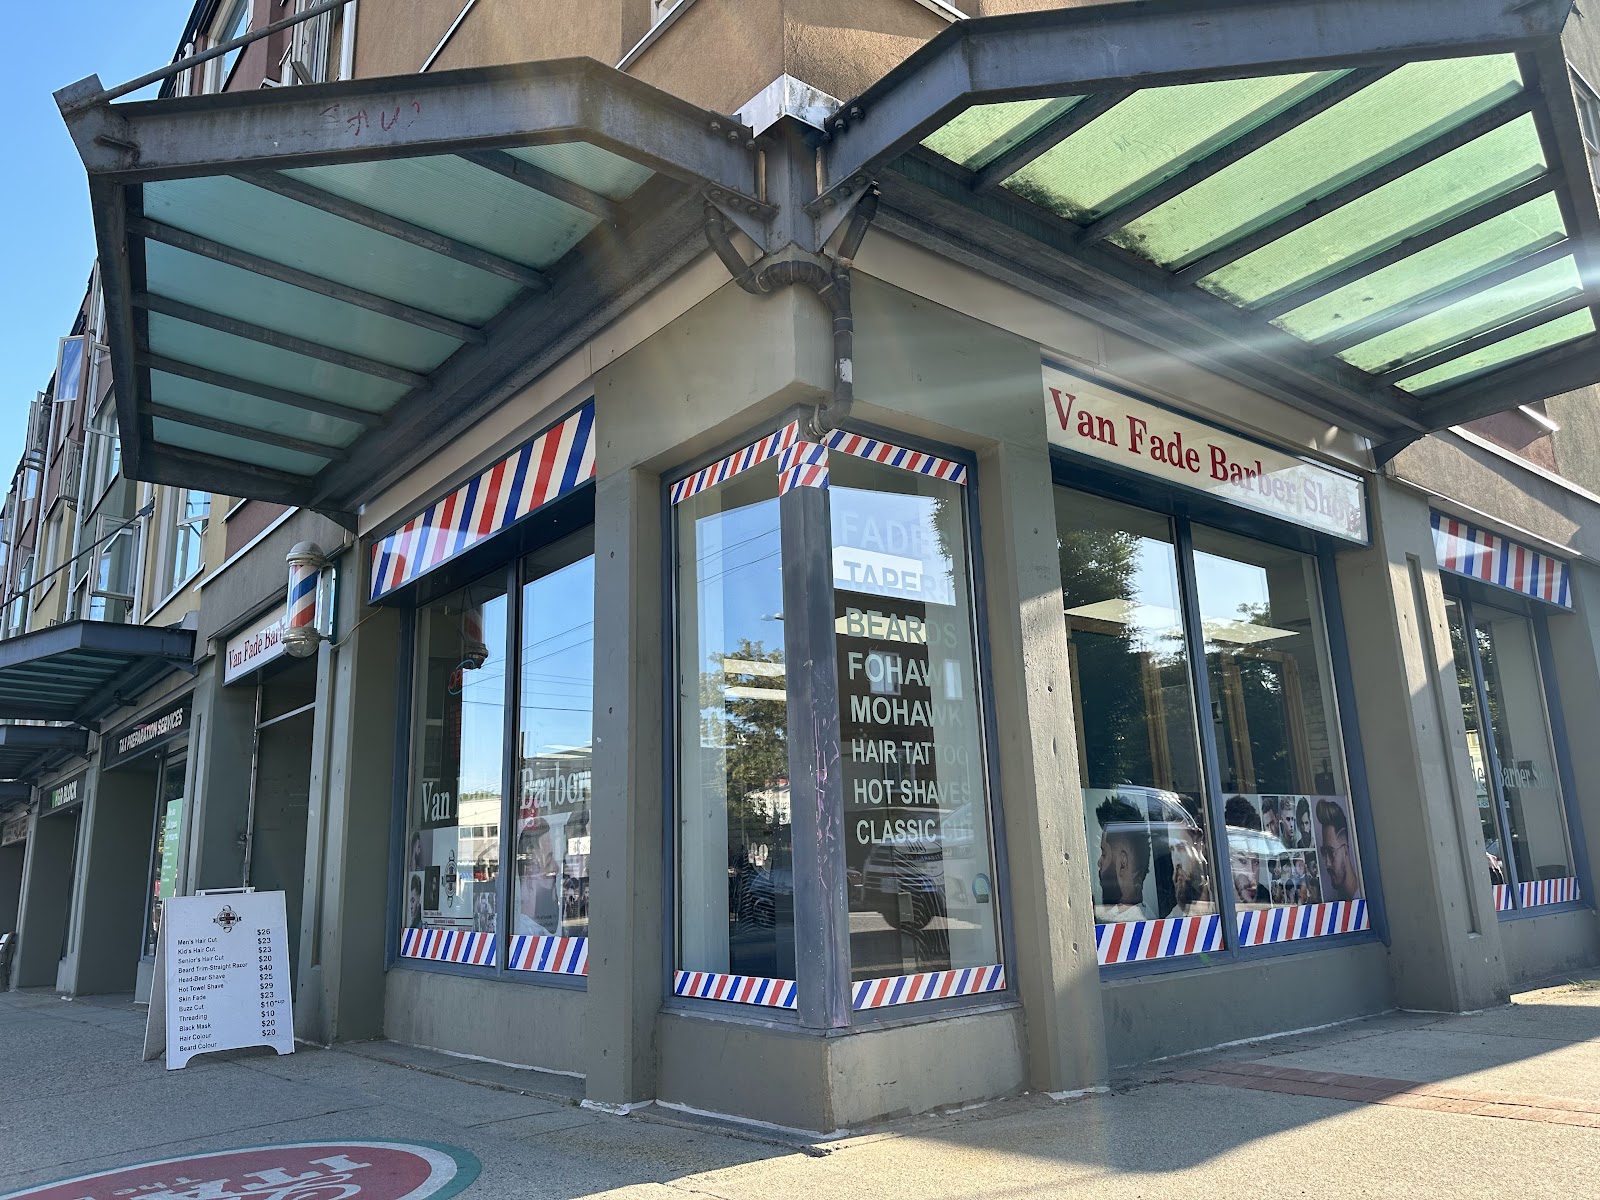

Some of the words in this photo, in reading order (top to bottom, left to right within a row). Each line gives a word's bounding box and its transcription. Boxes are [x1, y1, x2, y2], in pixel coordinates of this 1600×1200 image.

[1049, 387, 1118, 447] Van
[1126, 415, 1200, 473] Fade
[1207, 444, 1296, 505] Barber
[1304, 479, 1361, 533] Shop
[846, 607, 958, 649] BEARDS
[229, 649, 242, 670] Van
[244, 633, 263, 662] Fade
[264, 618, 287, 650] Barb
[848, 651, 955, 688] FOHAW
[851, 694, 963, 728] MOHAWK
[852, 738, 898, 764] HAIR
[902, 740, 968, 766] TATTOO
[520, 760, 592, 812] Barber
[854, 779, 895, 804] HOT
[901, 779, 971, 805] SHAVES
[422, 781, 451, 822] Van
[857, 819, 937, 845] CLASSIC
[257, 937, 271, 945] $23
[258, 946, 272, 954] $23
[258, 955, 272, 963] $20
[259, 964, 273, 972] $40
[259, 973, 273, 981] $25
[190, 984, 206, 992] Towel
[260, 982, 274, 990] $29
[178, 995, 192, 1003] Skin
[260, 991, 274, 999] $23
[179, 1013, 208, 1022] Threading
[261, 1010, 275, 1018] $10
[179, 1024, 196, 1032] Black
[196, 1022, 212, 1030] Mask
[261, 1019, 276, 1028] $20
[261, 1028, 276, 1037] $20
[179, 1034, 192, 1042] Hair
[192, 1033, 212, 1041] Colour
[179, 1044, 197, 1052] Beard
[197, 1042, 217, 1050] Colour
